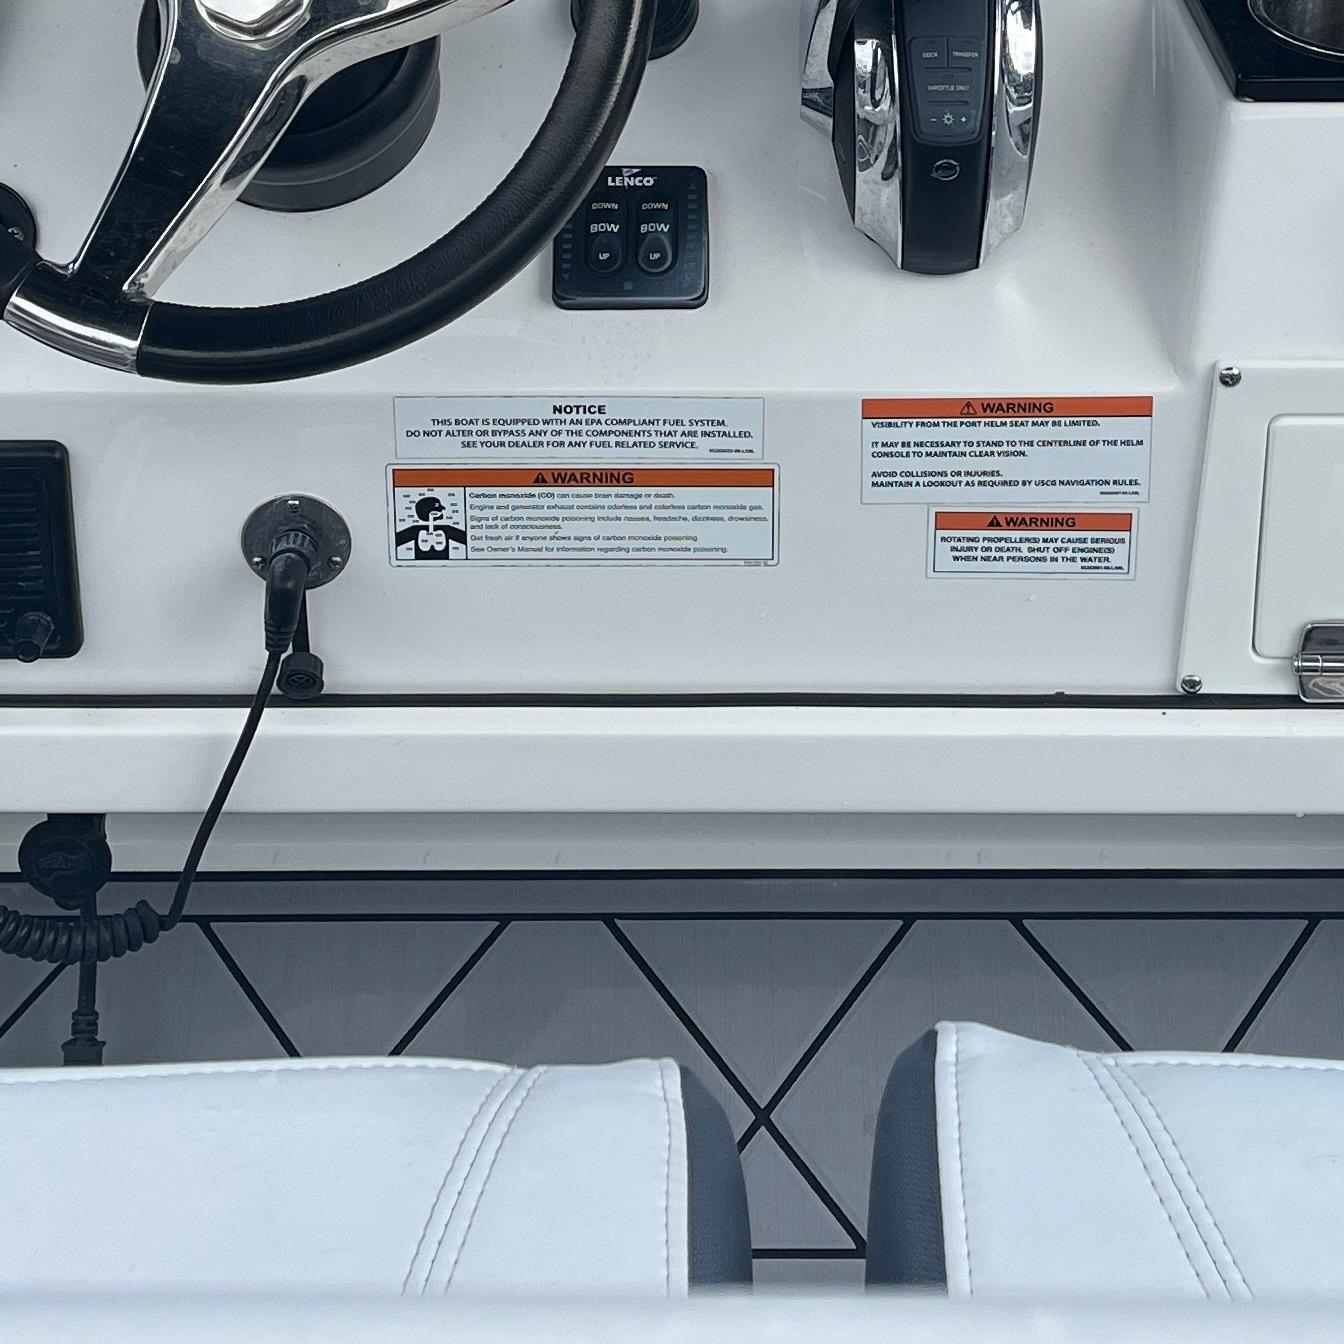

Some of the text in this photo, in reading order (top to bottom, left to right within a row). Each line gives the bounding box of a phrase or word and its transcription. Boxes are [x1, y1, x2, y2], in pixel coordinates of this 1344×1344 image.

[607, 176, 655, 188] LENCO
[590, 223, 620, 233] BOW
[640, 223, 670, 233] BOW
[598, 252, 610, 260] UP
[649, 252, 661, 260] UP
[552, 405, 607, 415] NOTICE
[981, 402, 1054, 414] WARNING
[431, 418, 452, 426] THIS
[454, 418, 479, 426] BOAT
[481, 418, 491, 426] IS
[492, 418, 540, 426] EQUIPPED
[541, 418, 567, 426] WITH
[568, 418, 583, 426] AN
[585, 418, 603, 426] EPA
[604, 418, 661, 426] COMPLIANT
[662, 418, 686, 426] FUEL
[915, 420, 940, 428] FROM
[941, 420, 958, 428] THE
[959, 420, 982, 428] PORT
[983, 420, 1007, 428] HELM
[1009, 420, 1029, 428] SEAT
[1063, 419, 1100, 427] LIMITED.
[406, 430, 754, 438] DO NOT ALTER OR BYPASS ANY OF THE COMPONENTS THAT ARE INSTALLED.
[461, 440, 699, 449] SEE YOUR DEALER FOR ANY FUEL RELATED SERVICE.
[871, 440, 879, 448] IT
[880, 440, 899, 448] MAY
[913, 440, 962, 448] NECESSARY
[963, 440, 974, 448] TO
[975, 440, 1004, 448] STAND
[1005, 440, 1017, 448] TO
[1088, 439, 1099, 447] OF
[1102, 439, 1118, 447] THE
[1119, 439, 1143, 447] HELM
[871, 450, 1028, 458] CONSOLE TO MAINTAIN CLEAR VISION.
[551, 472, 634, 484] WARNING
[870, 470, 897, 478] AVOID
[899, 470, 949, 478] COLLISIONS
[950, 470, 962, 478] OR
[871, 480, 913, 488] MAINTAIN
[914, 480, 921, 488] A
[922, 480, 963, 488] LOOKOUT
[964, 480, 975, 488] AS
[977, 480, 1020, 488] REQUIRED
[1058, 479, 1111, 487] NAVIGATION
[1112, 479, 1141, 487] RULES.
[1004, 517, 1076, 528] WARNING
[1052, 546, 1070, 554] OFF
